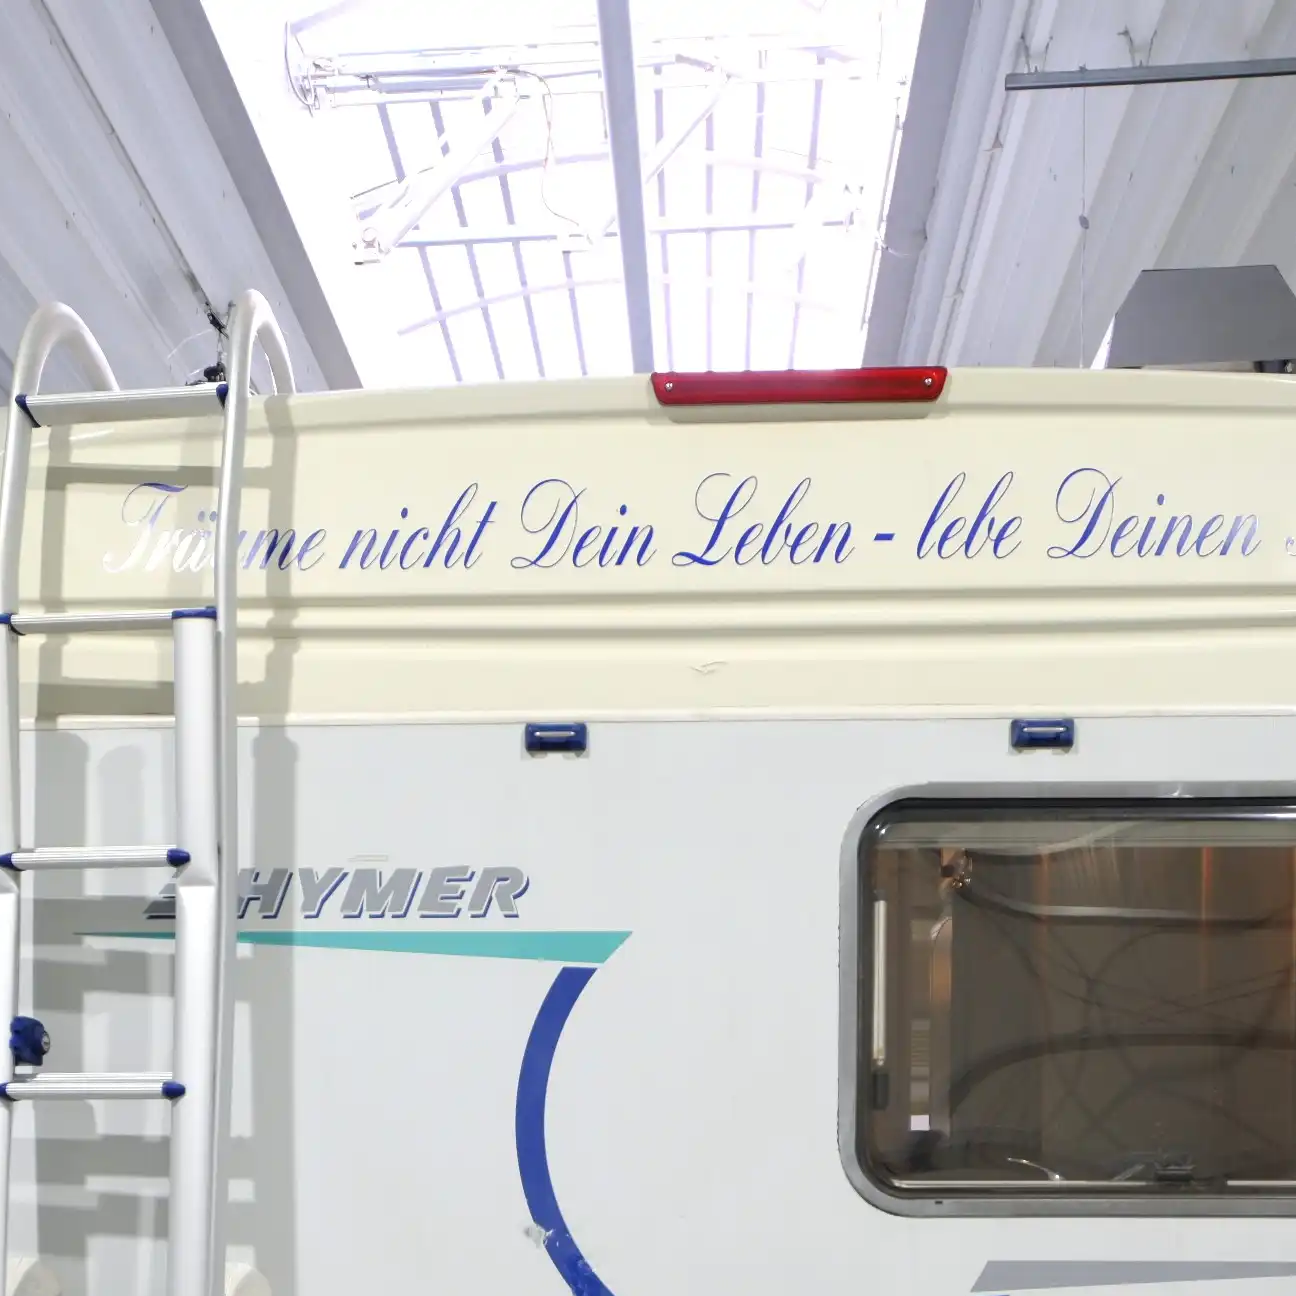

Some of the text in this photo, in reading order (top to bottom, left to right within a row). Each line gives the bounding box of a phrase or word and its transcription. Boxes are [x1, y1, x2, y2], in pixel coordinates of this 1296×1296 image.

[103, 481, 328, 574] Träme
[338, 482, 497, 571] nicht
[510, 478, 657, 570] Dein
[671, 472, 855, 566] Leben
[916, 471, 1022, 560] lebe
[1047, 467, 1261, 559] Deinen
[234, 865, 531, 919] HYMER
